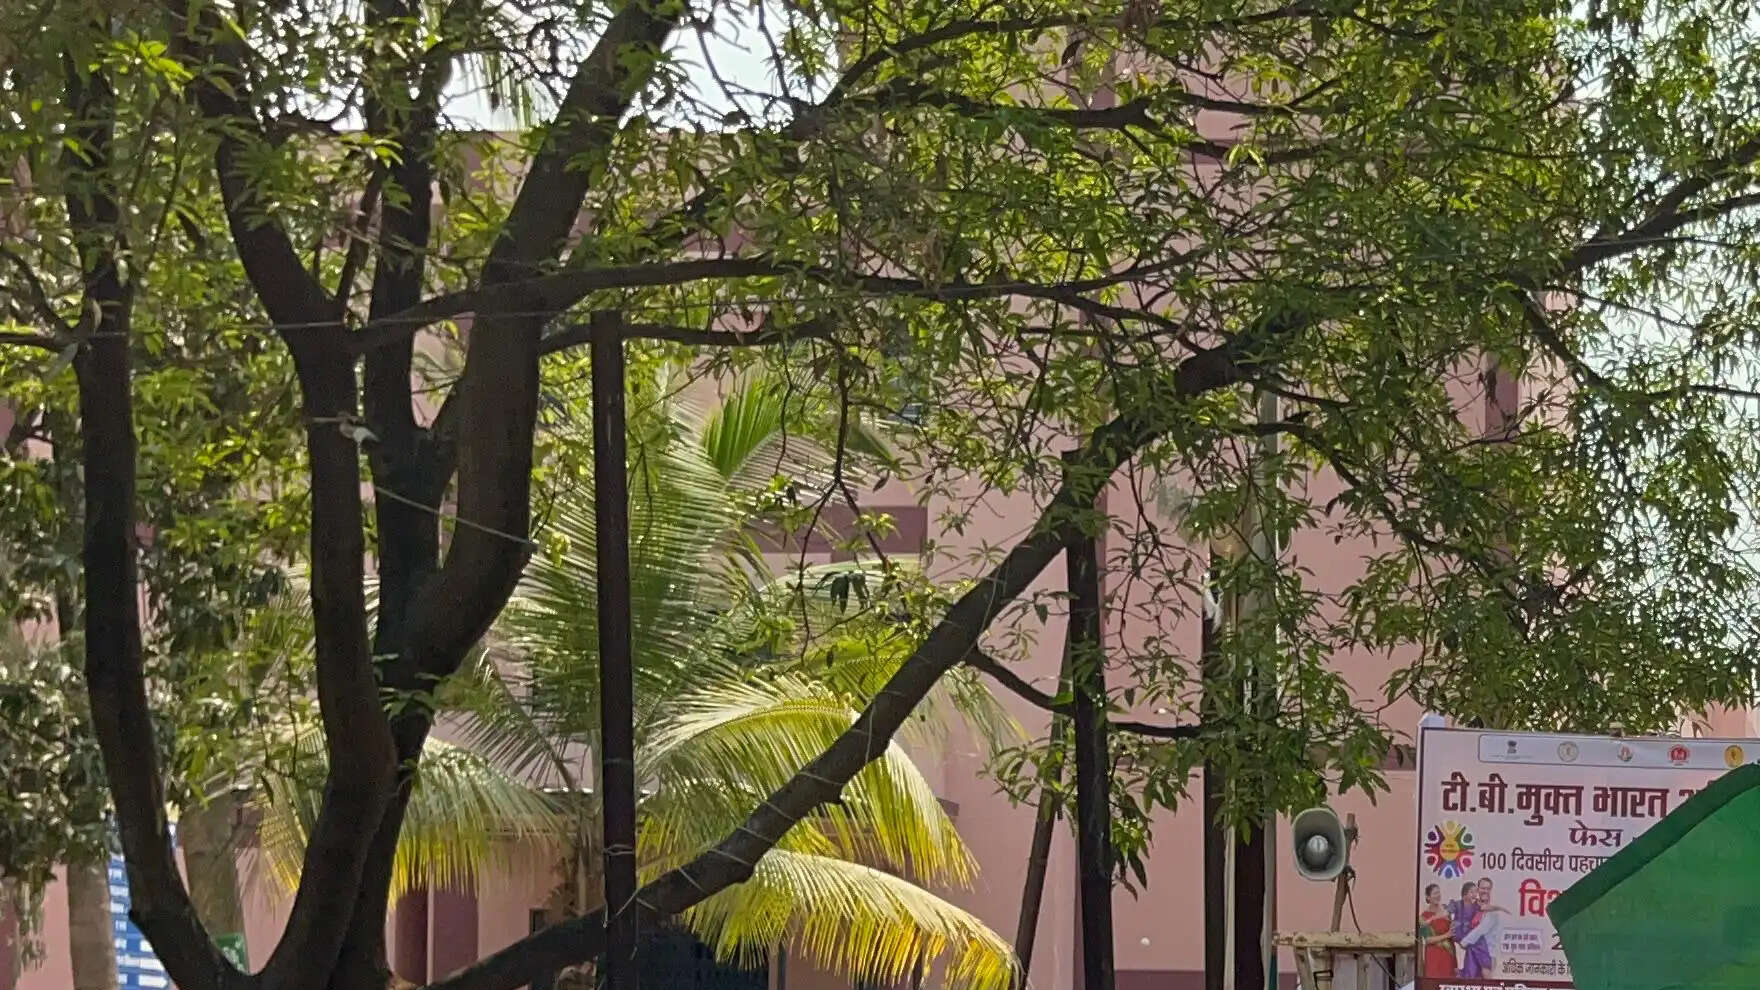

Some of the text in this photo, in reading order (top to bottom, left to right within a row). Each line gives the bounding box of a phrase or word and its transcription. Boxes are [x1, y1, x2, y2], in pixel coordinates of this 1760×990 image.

[1592, 786, 1669, 818] भारत
[1568, 820, 1624, 847] फेस
[1479, 853, 1505, 871] 100
[1511, 847, 1564, 872] दिवसीय
